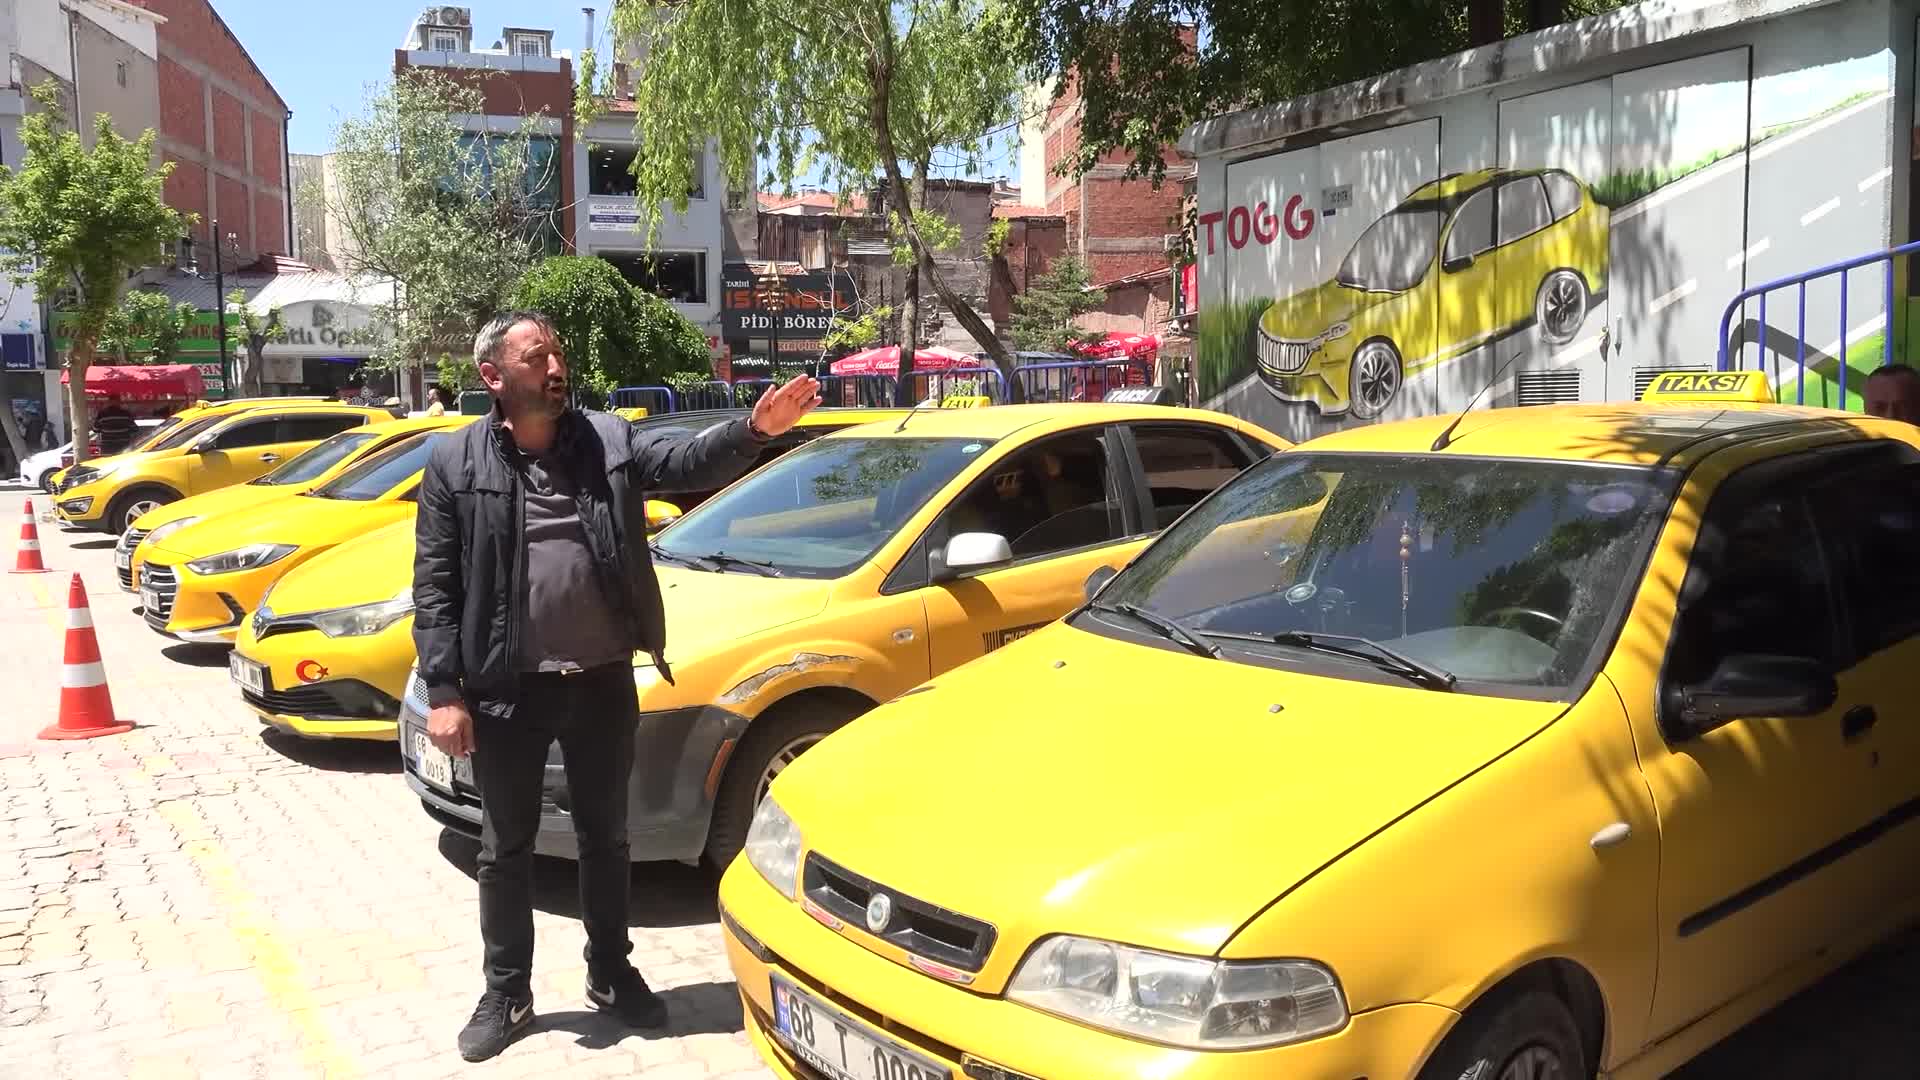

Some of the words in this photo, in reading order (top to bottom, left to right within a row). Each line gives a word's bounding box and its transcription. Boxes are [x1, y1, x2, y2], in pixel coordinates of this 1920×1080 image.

[1199, 194, 1315, 256] TOGG
[788, 994, 816, 1048] 68
[833, 1022, 848, 1070] T
[872, 1046, 942, 1080] 00
